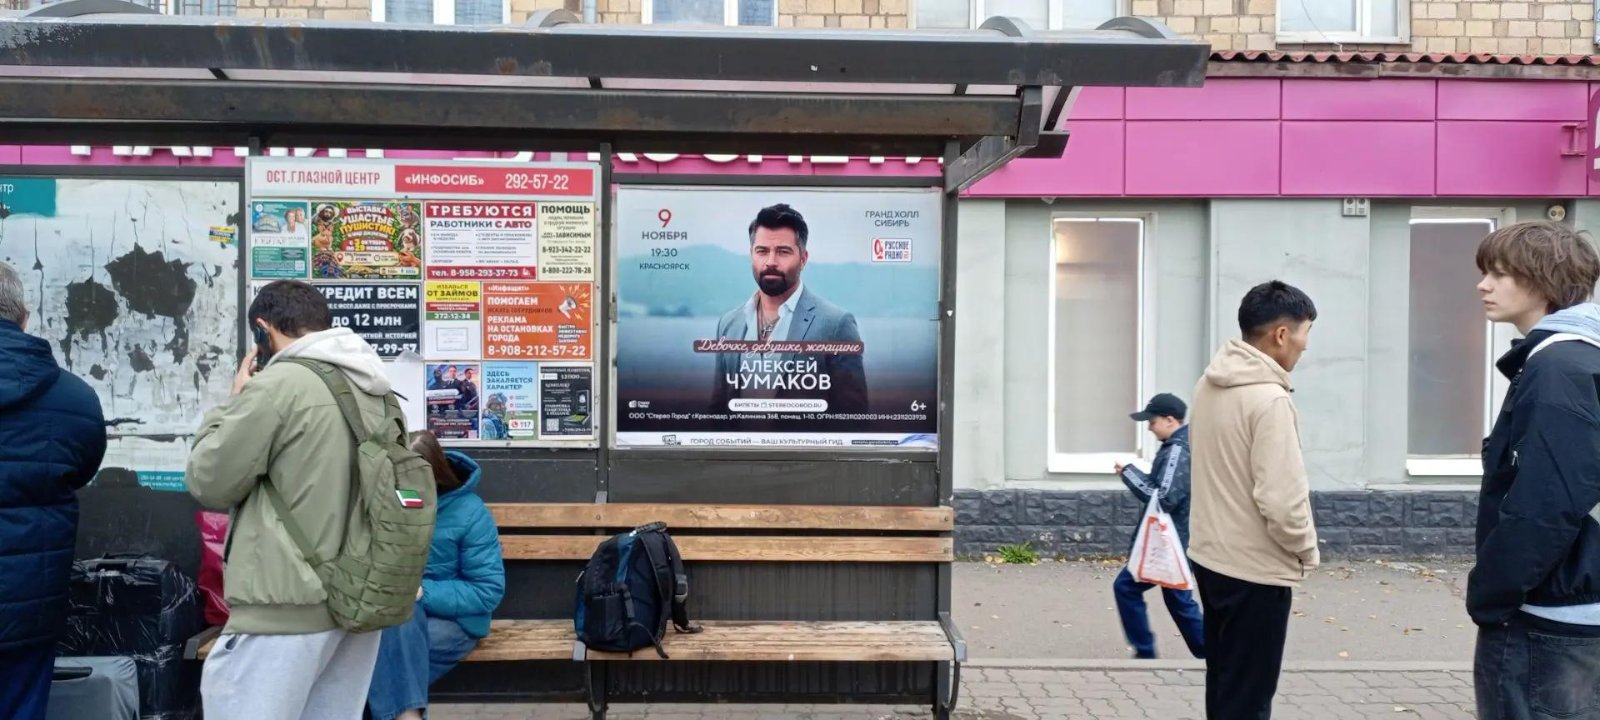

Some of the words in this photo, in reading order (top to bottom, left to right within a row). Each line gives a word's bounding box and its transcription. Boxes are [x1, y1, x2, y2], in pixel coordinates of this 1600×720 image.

[345, 172, 380, 186] ЦЕНТР
[405, 173, 484, 186] «ИНФОСИБ»
[505, 173, 569, 190] 292-57-22
[430, 205, 532, 217] ТРЕБУЮТСЯ
[541, 205, 591, 215] ПОМОЩЬ
[865, 210, 893, 219] ГРАНД
[894, 210, 920, 218] ХОЛЛ
[340, 213, 394, 227] УШАСТЫЕ
[658, 208, 672, 229] 9
[874, 219, 910, 227] СИБИРЬ
[430, 220, 493, 228] РАБОТНИКИ
[495, 220, 502, 229] С
[504, 220, 532, 229] АВТО
[641, 231, 688, 240] НОЯБРЯ
[650, 248, 678, 257] 19:30
[377, 287, 417, 300] ВСЕМ
[440, 289, 478, 297] ЗАЙМОВ
[487, 296, 538, 305] ПОМОГАЕМ
[353, 313, 370, 326] 12
[487, 315, 527, 324] РЕКЛАМА
[487, 325, 500, 333] НА
[500, 325, 553, 333] ОСТАНОВКАХ
[487, 334, 519, 342] ГОРОДА
[370, 343, 417, 353] 7-99-57
[487, 345, 586, 356] 8-908-212-57-22
[739, 357, 818, 373] АЛЕКСЕЙ
[725, 373, 832, 390] ЧУМАКОВ
[910, 400, 927, 412] 6+
[690, 438, 714, 446] ГОРОД
[715, 437, 751, 445] СОБЫТИЙ
[828, 438, 843, 446] ГИД
